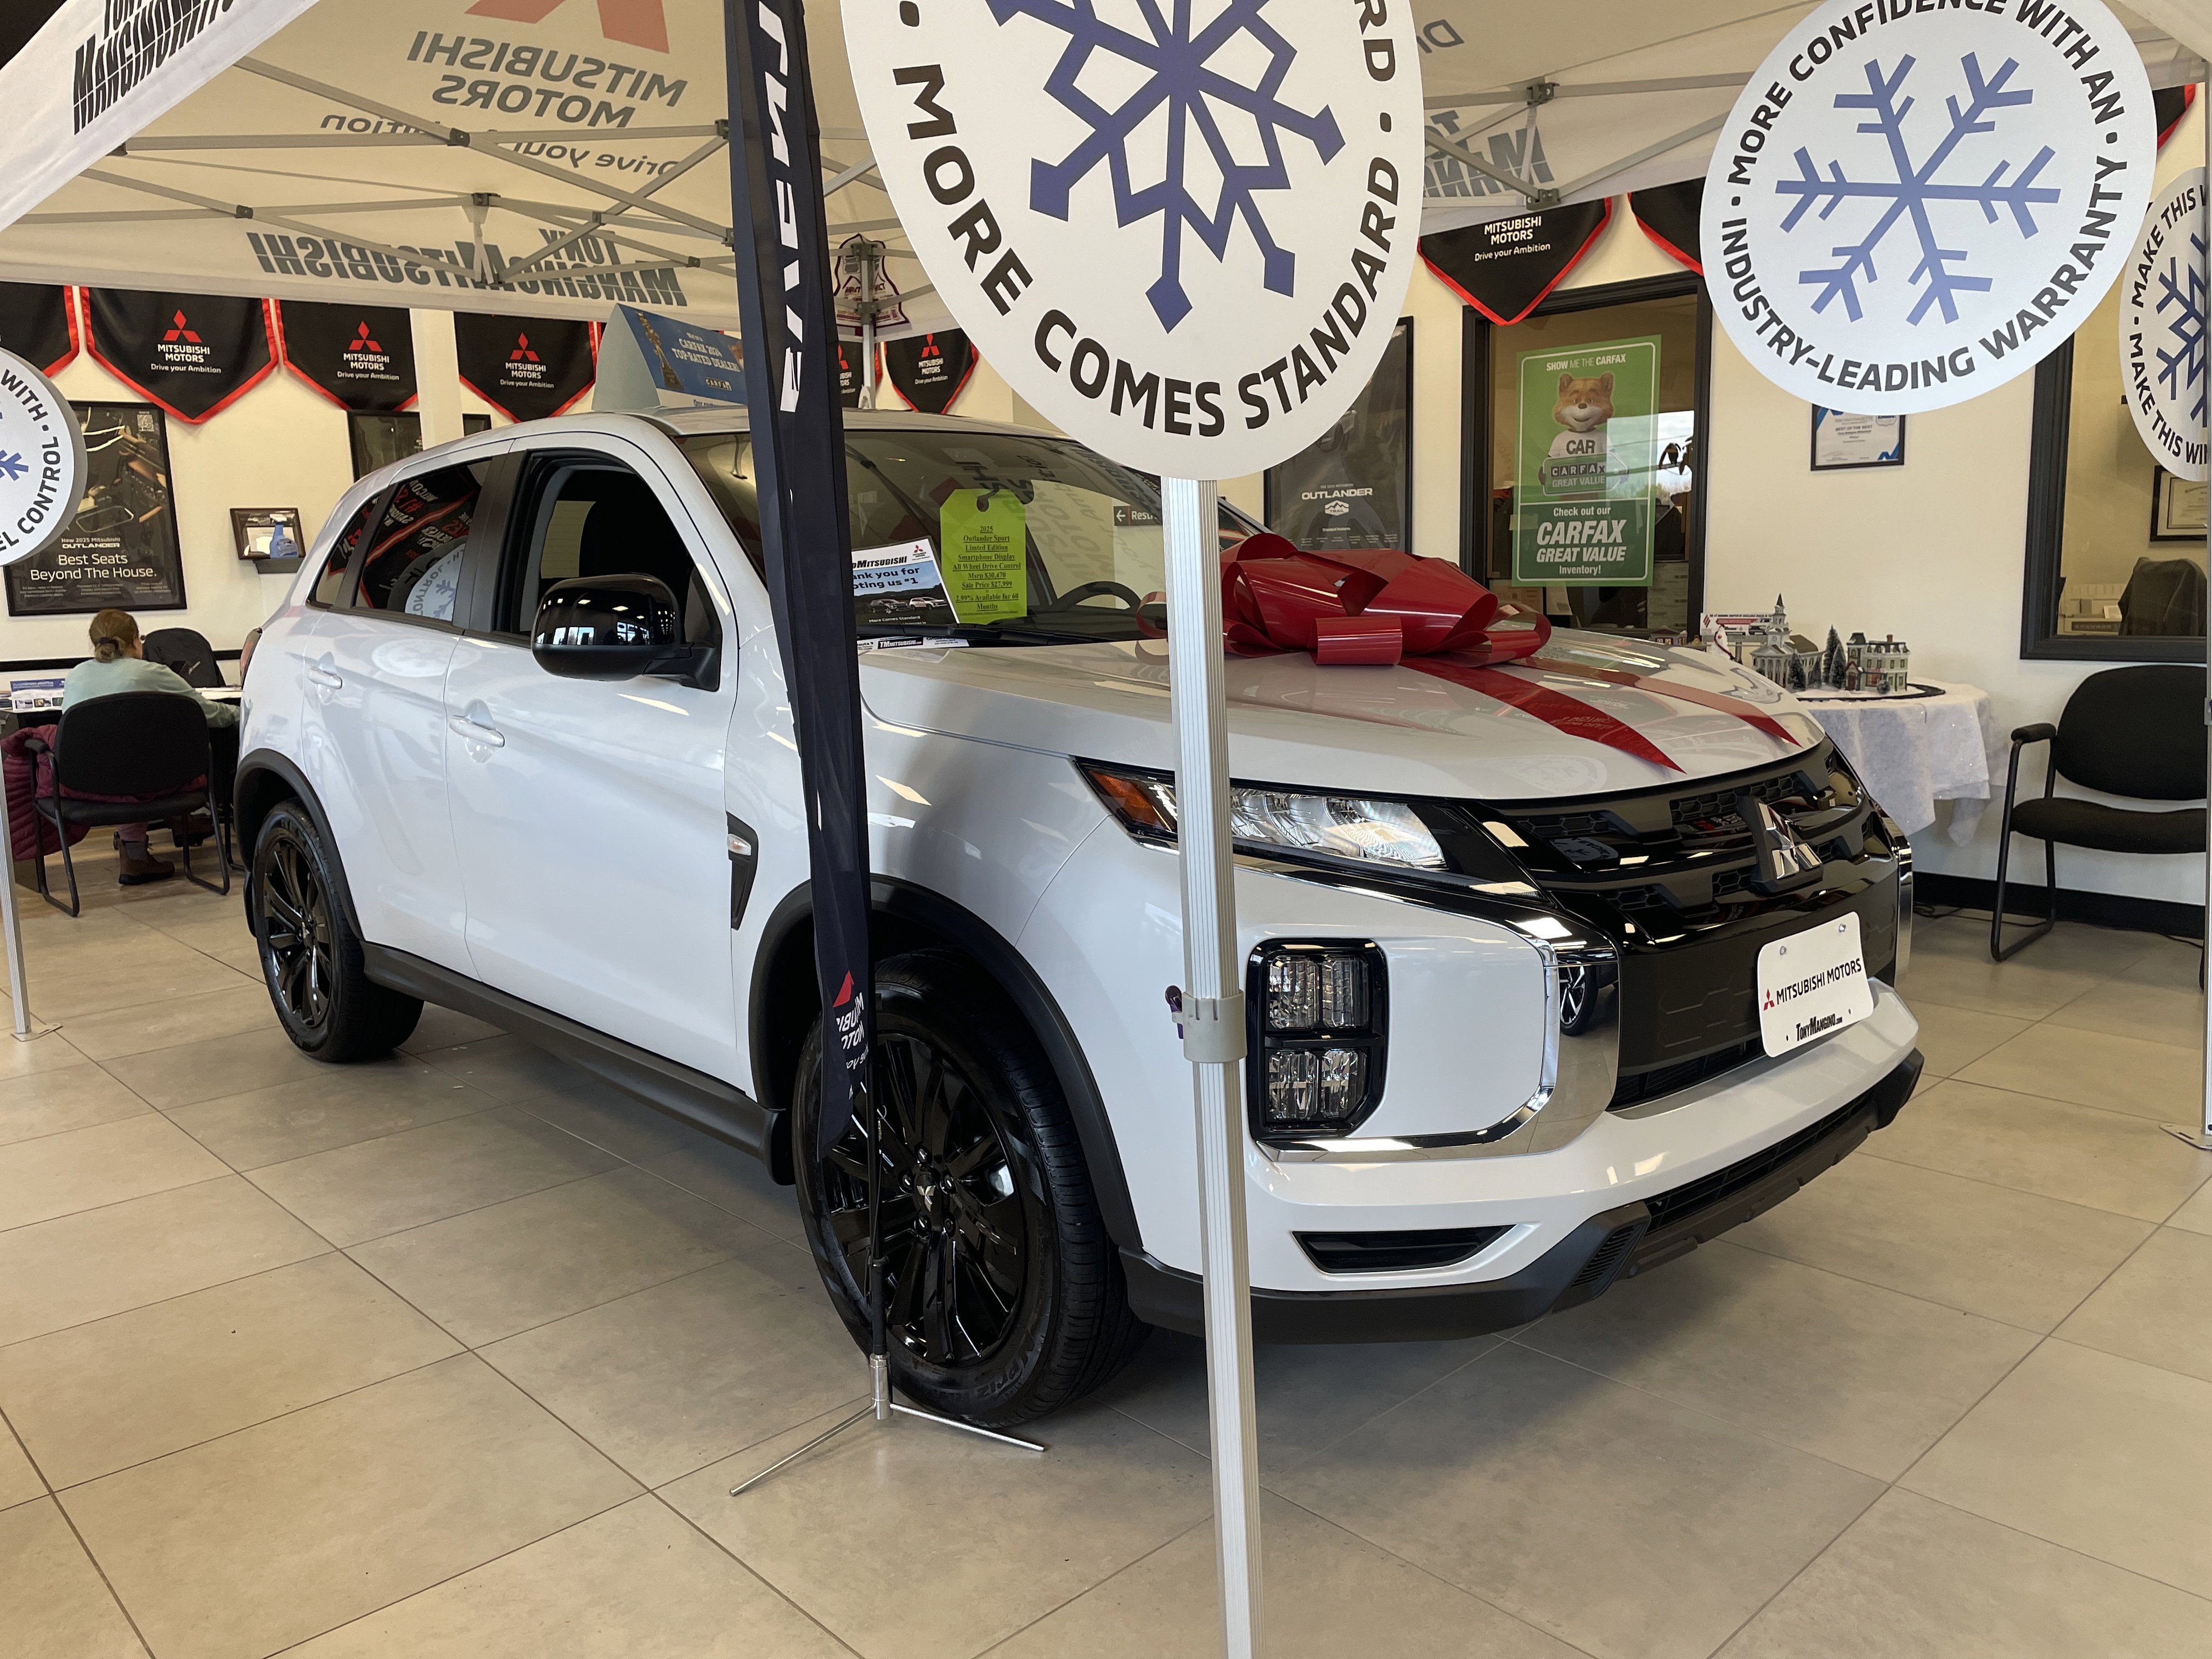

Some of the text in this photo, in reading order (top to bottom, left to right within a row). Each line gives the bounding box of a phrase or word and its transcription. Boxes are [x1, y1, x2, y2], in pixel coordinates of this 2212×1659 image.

[1728, 81, 1793, 185] MORE
[2014, 0, 2100, 70] WITH
[2080, 71, 2124, 125] AN
[1484, 216, 1542, 235] MITSUBISHI
[1491, 229, 1533, 245] MOTORS
[893, 64, 1033, 316] MORE
[1034, 309, 1224, 437] COMES
[1238, 157, 1400, 430] STANDARD
[1475, 242, 1550, 262] Drive your Ambition
[2131, 187, 2196, 308] MAKE THIS
[1722, 155, 2127, 392] INDUSTRY-LEADING WARRANTY
[157, 344, 210, 355] MITSUBISHI
[165, 353, 204, 363] MOTORS
[343, 353, 390, 363] MITSUBISHI
[351, 360, 385, 371] MOTORS
[1547, 354, 1626, 371] SHOW ME THE CARFAX
[151, 363, 221, 374] Drive your Ambition
[505, 362, 547, 373] MITSUBISHI
[511, 370, 541, 379] MOTORS
[528, 381, 554, 389] Ambition
[1, 369, 49, 422] WITH
[2130, 332, 2155, 415] MAKE
[2152, 409, 2182, 457] THIS
[1566, 439, 1596, 454] CAR
[1551, 462, 1606, 477] CARFAX
[17, 436, 61, 534] CONTROL
[1553, 476, 1606, 488] GREAT VALUE
[1301, 488, 1373, 500] OUTLANDER
[1553, 506, 1611, 517] Check out our
[1537, 520, 1627, 545] CARFAX
[58, 553, 128, 566] Best Seats
[1536, 546, 1627, 563] GREAT VALUE
[30, 567, 157, 582] Beyond The House.
[875, 571, 899, 579] you
[1559, 565, 1601, 576] Inventory!
[1776, 958, 1861, 1005] MITSUBISHI MOTORS
